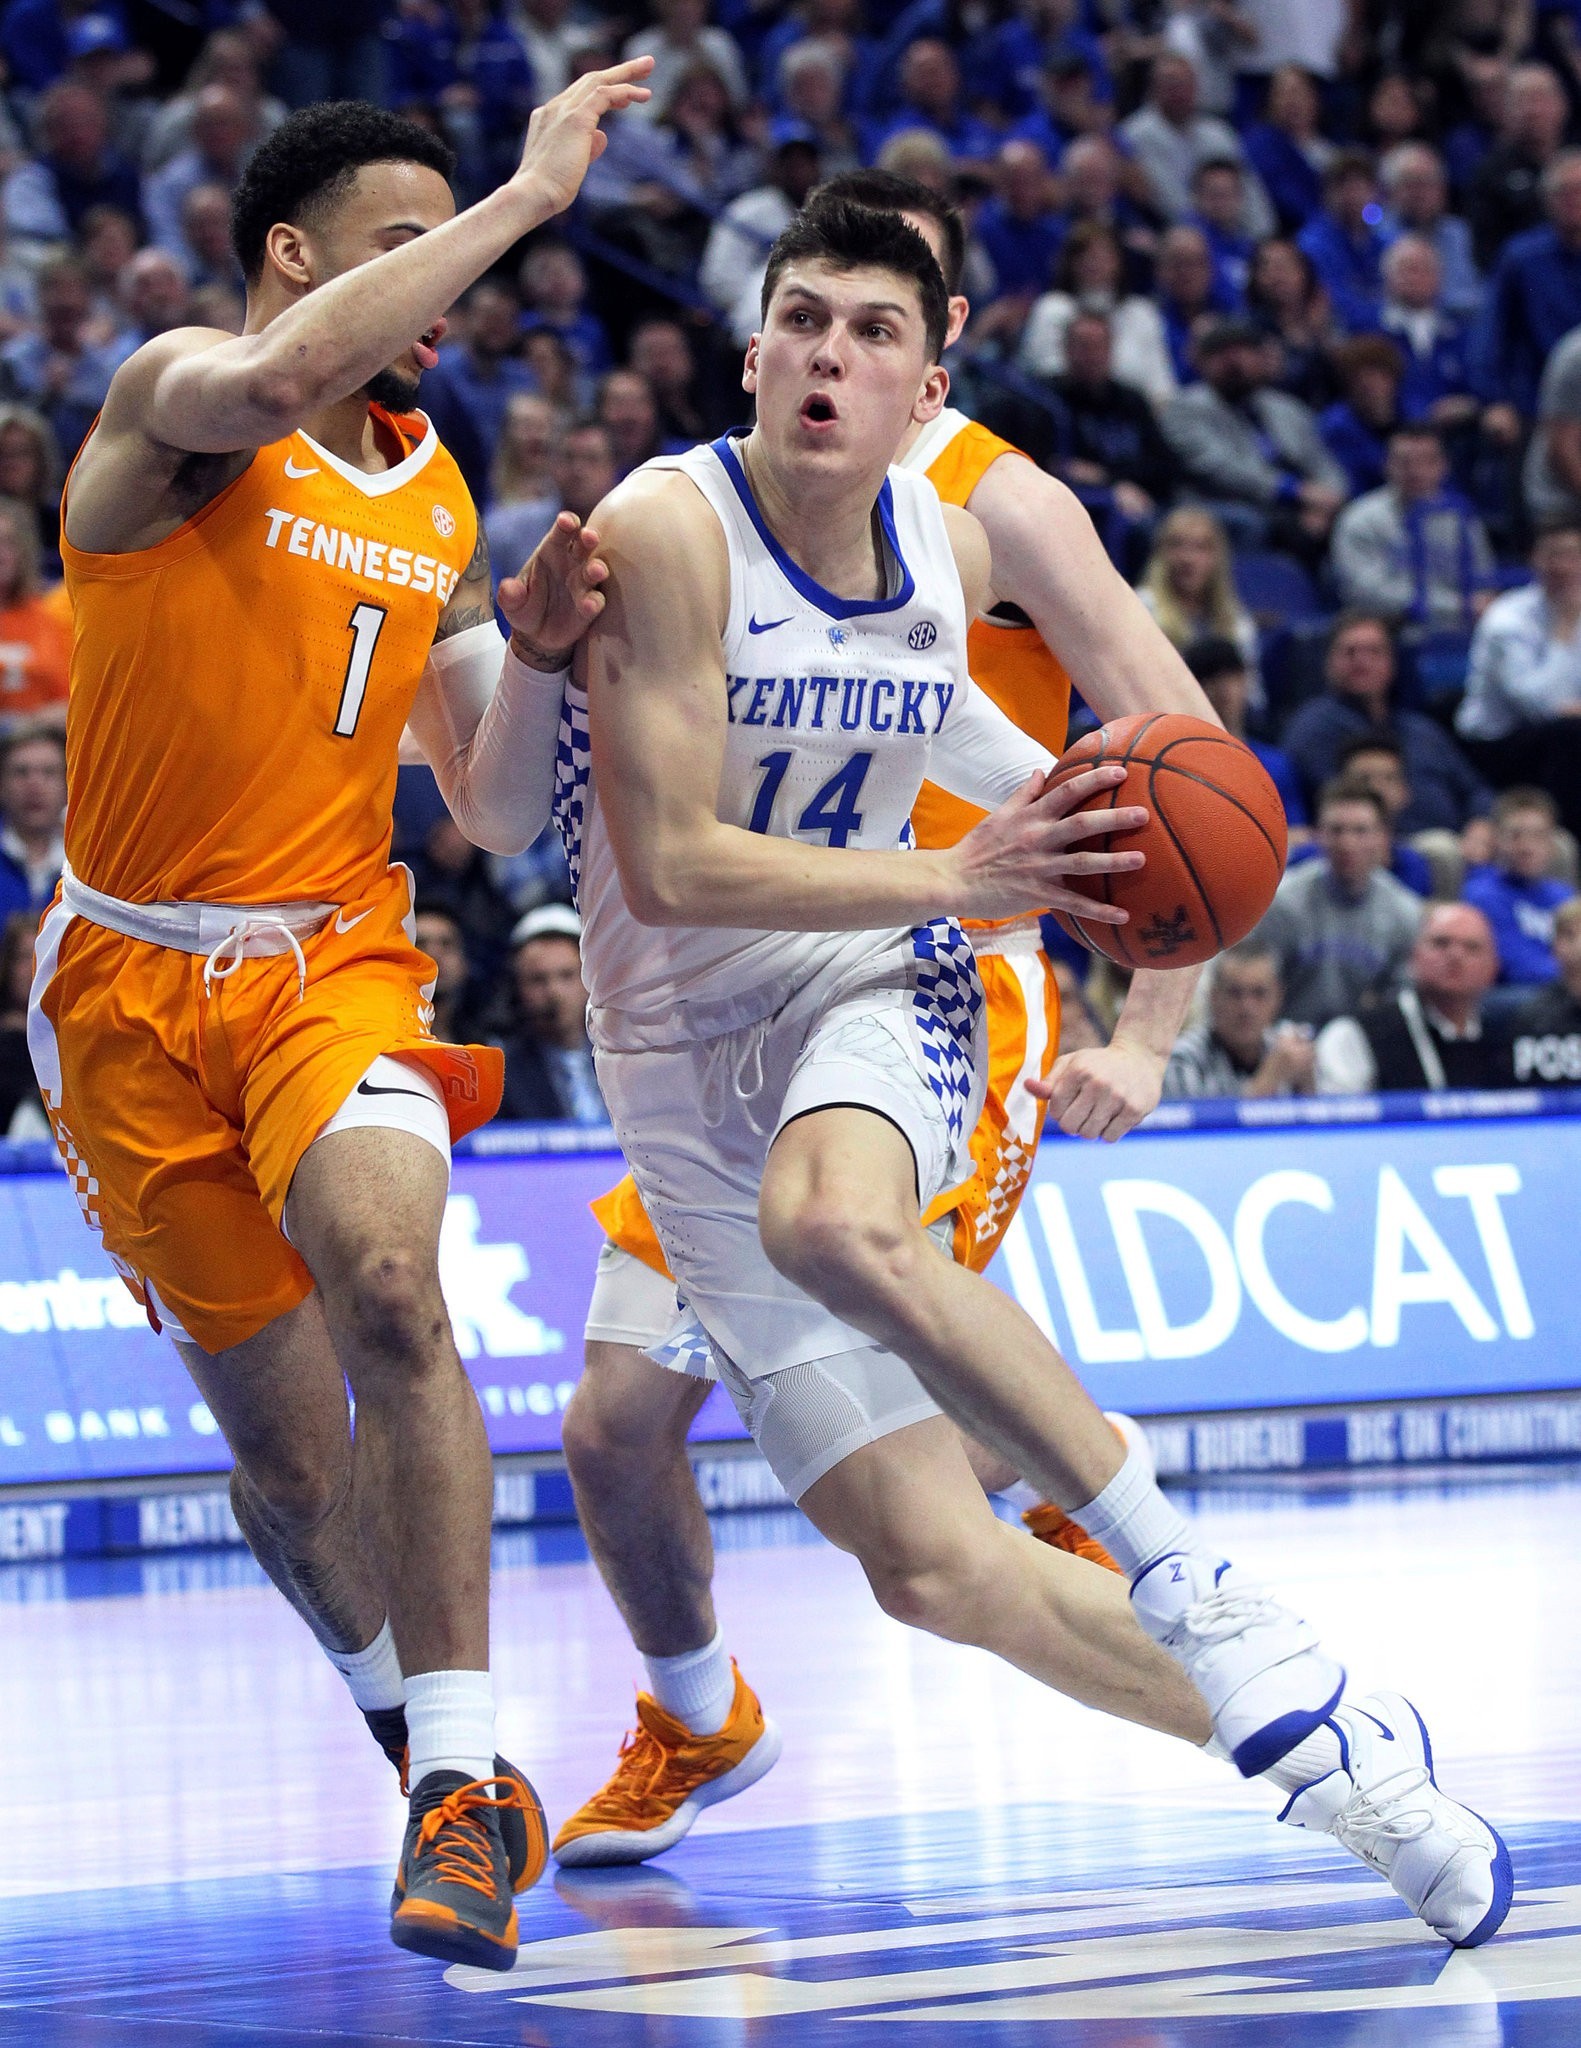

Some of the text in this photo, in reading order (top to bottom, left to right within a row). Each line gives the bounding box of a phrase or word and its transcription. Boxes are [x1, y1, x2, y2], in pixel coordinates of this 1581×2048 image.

[332, 601, 388, 739] 1
[909, 623, 935, 649] SEC
[726, 673, 955, 735] KENTUCKY
[750, 749, 874, 848] 14
[1000, 1164, 1535, 1364] ILDCAT
[45, 1406, 169, 1443] BANK
